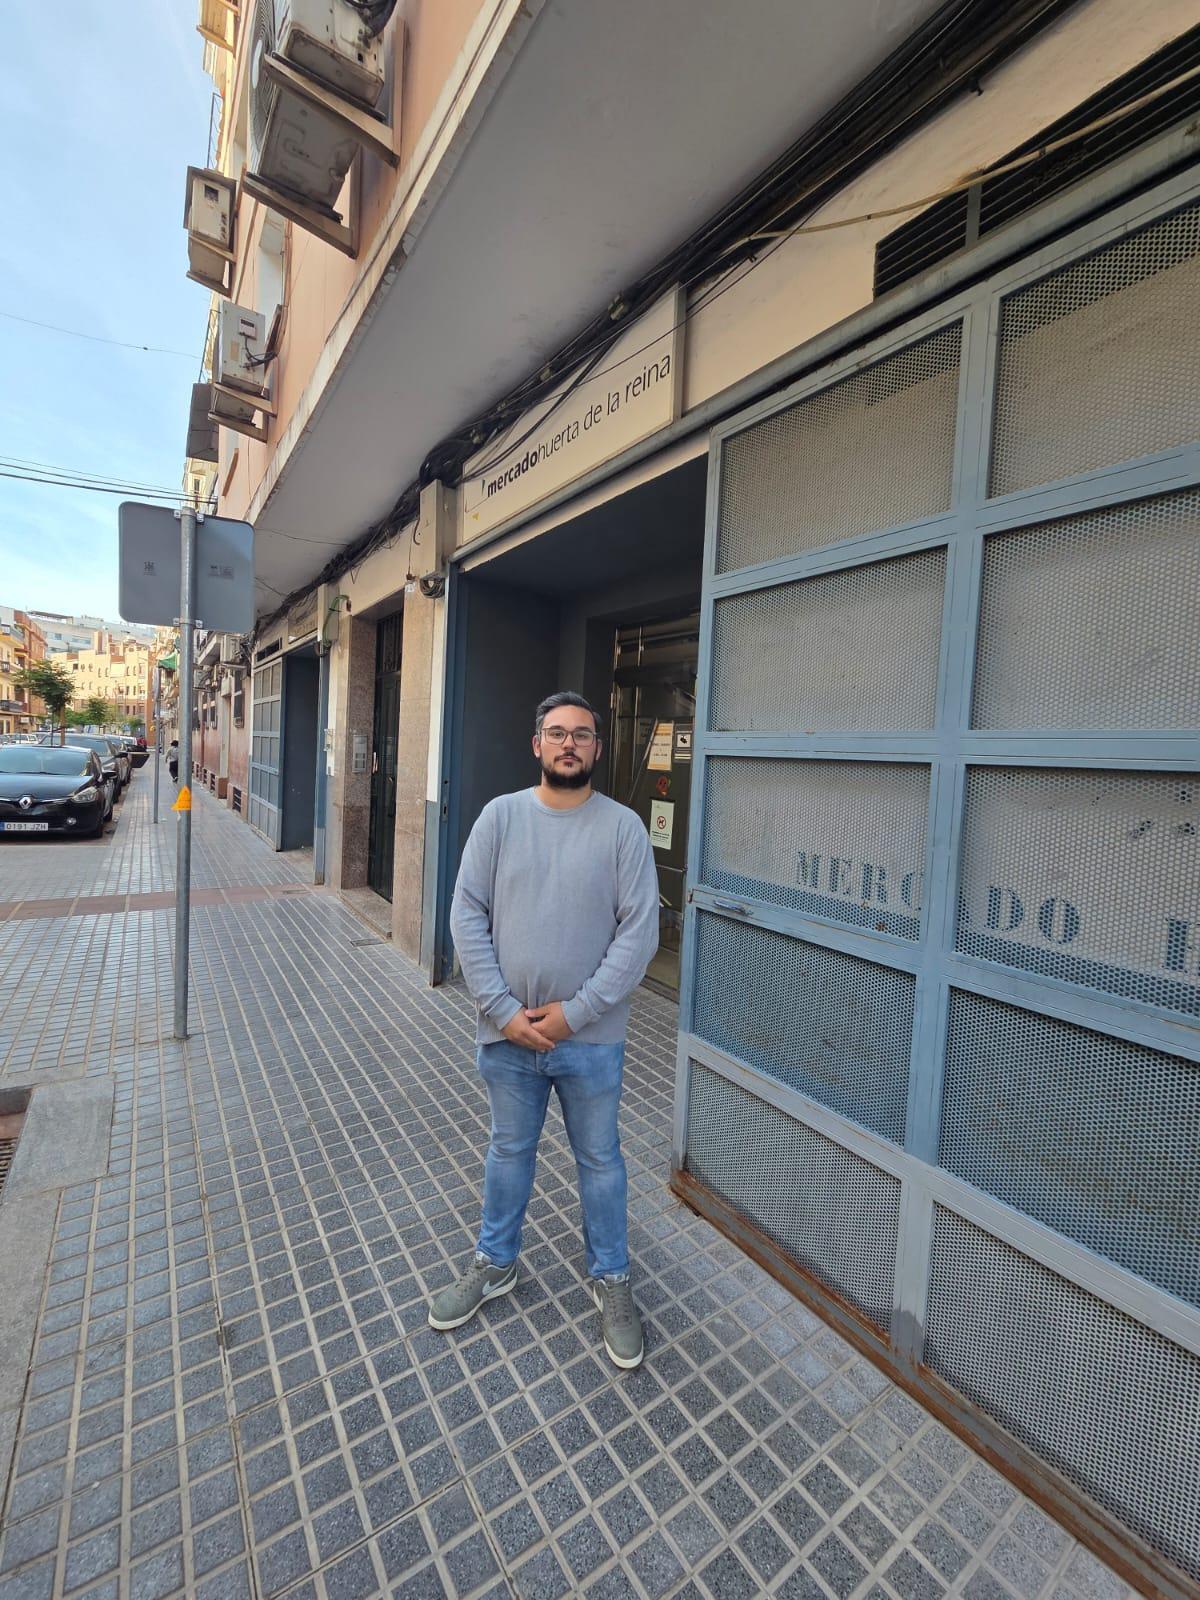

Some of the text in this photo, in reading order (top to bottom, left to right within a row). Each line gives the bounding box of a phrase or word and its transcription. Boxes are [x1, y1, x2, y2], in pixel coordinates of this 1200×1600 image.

[583, 405, 602, 431] de
[607, 392, 620, 416] la
[625, 354, 671, 403] reina
[797, 849, 1081, 945] MERCDO
